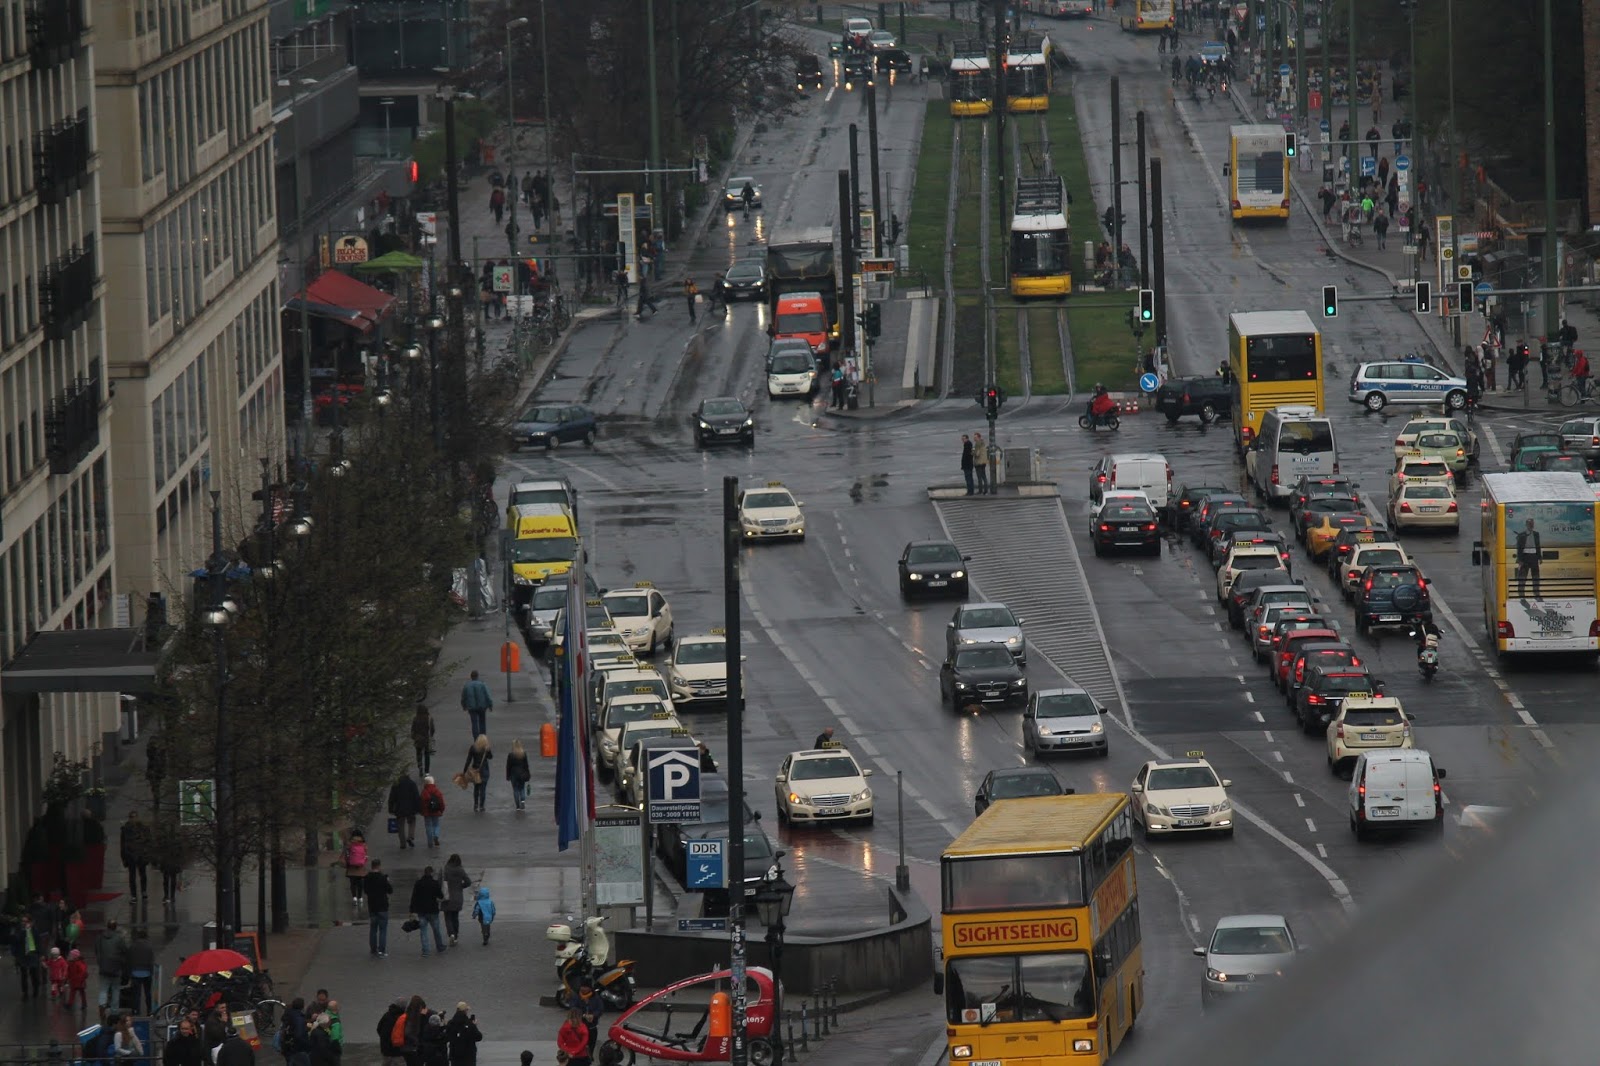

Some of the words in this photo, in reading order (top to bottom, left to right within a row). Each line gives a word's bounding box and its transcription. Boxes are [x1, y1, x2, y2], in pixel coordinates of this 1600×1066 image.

[663, 763, 690, 800] P
[692, 843, 718, 853] DDR
[957, 922, 1073, 943] SIGHTSEEING
